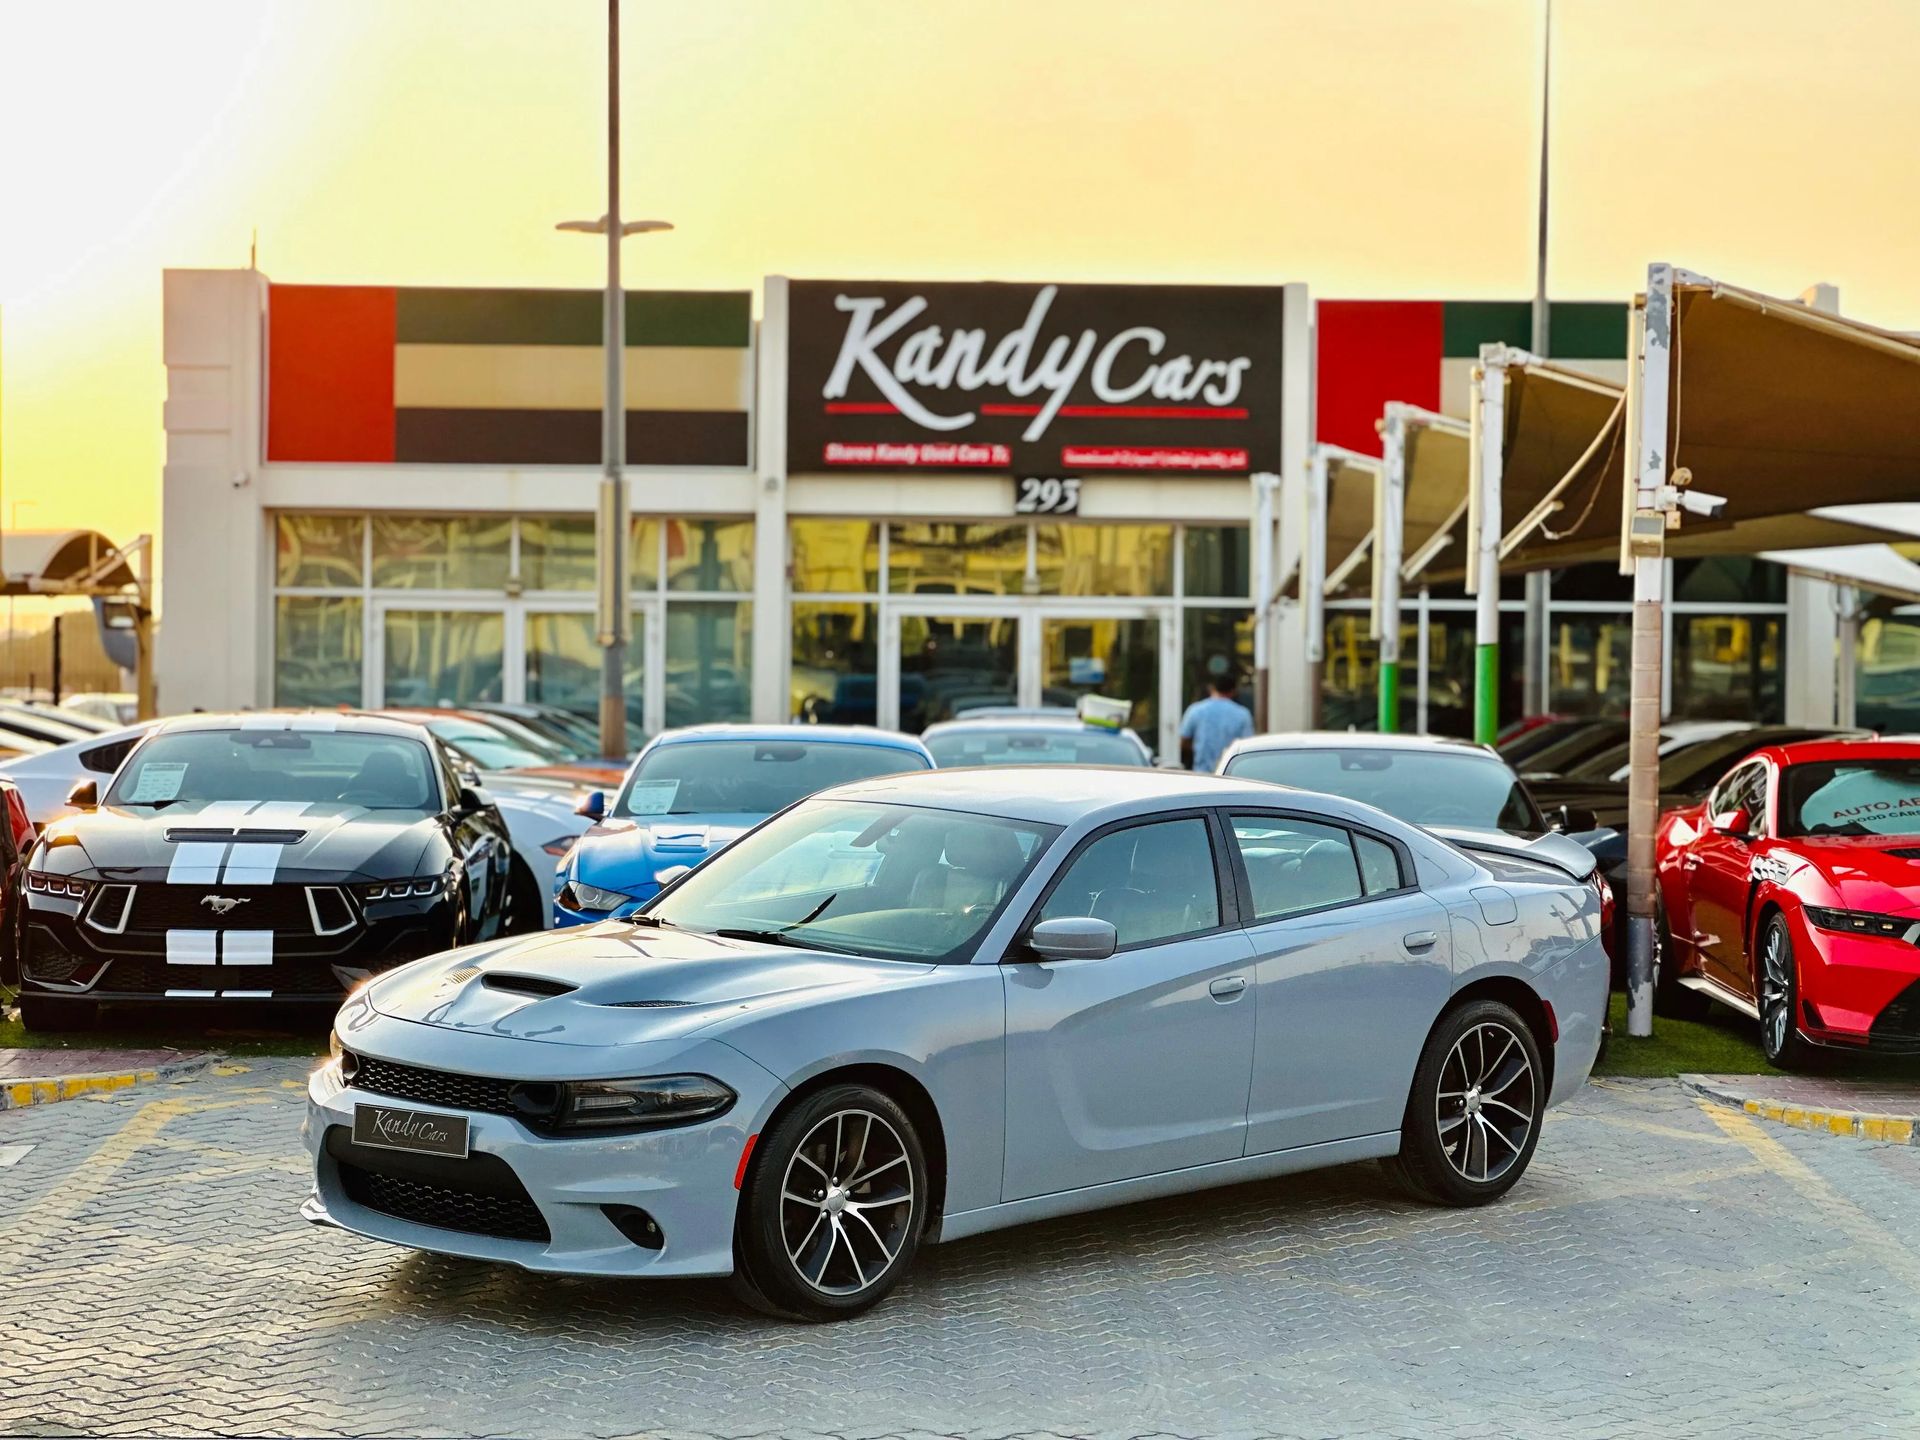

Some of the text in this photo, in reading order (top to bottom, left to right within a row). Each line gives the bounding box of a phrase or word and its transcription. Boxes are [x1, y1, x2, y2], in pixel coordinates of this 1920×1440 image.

[823, 285, 1252, 441] Kandy Cars
[1015, 477, 1082, 513] 295
[372, 1110, 448, 1147] Kandy Cars
